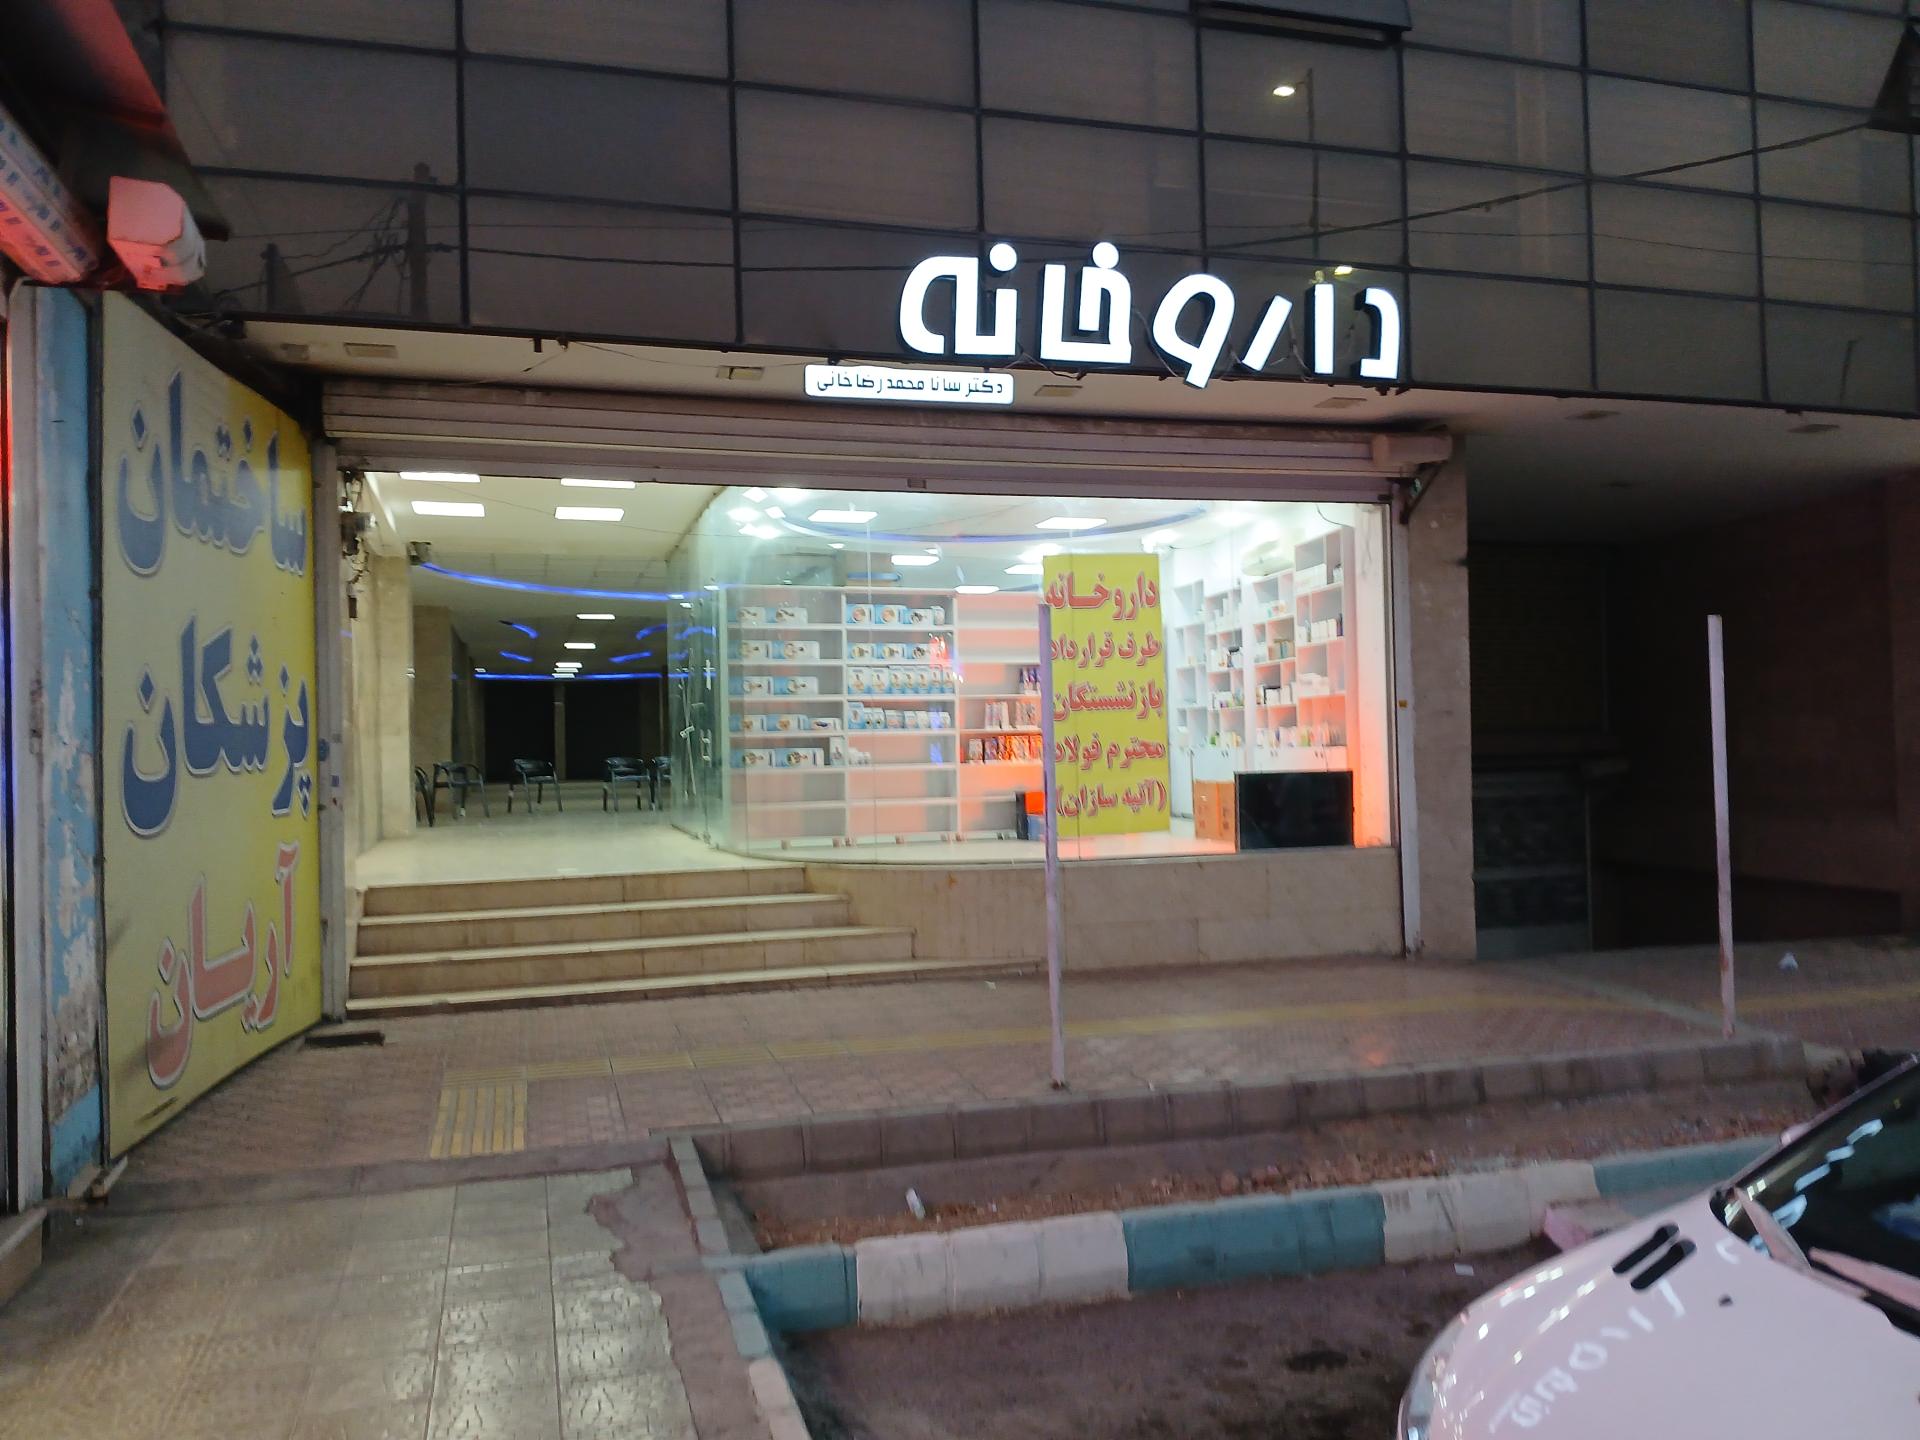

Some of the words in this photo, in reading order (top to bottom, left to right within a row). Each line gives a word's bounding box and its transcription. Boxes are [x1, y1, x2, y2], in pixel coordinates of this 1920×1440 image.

[900, 243, 1398, 388] داروخانه
[964, 376, 1003, 397] دکتر
[115, 368, 308, 577] ساختمان
[1044, 570, 1158, 620] داروخانه
[1050, 632, 1115, 668] قرارداد
[1117, 631, 1162, 667] طرف
[1053, 679, 1164, 721] بازنشستگان
[120, 611, 312, 838] پزشکان
[1055, 731, 1102, 771] فولاد
[1106, 735, 1166, 769] محترم
[145, 840, 298, 1089] آریان
